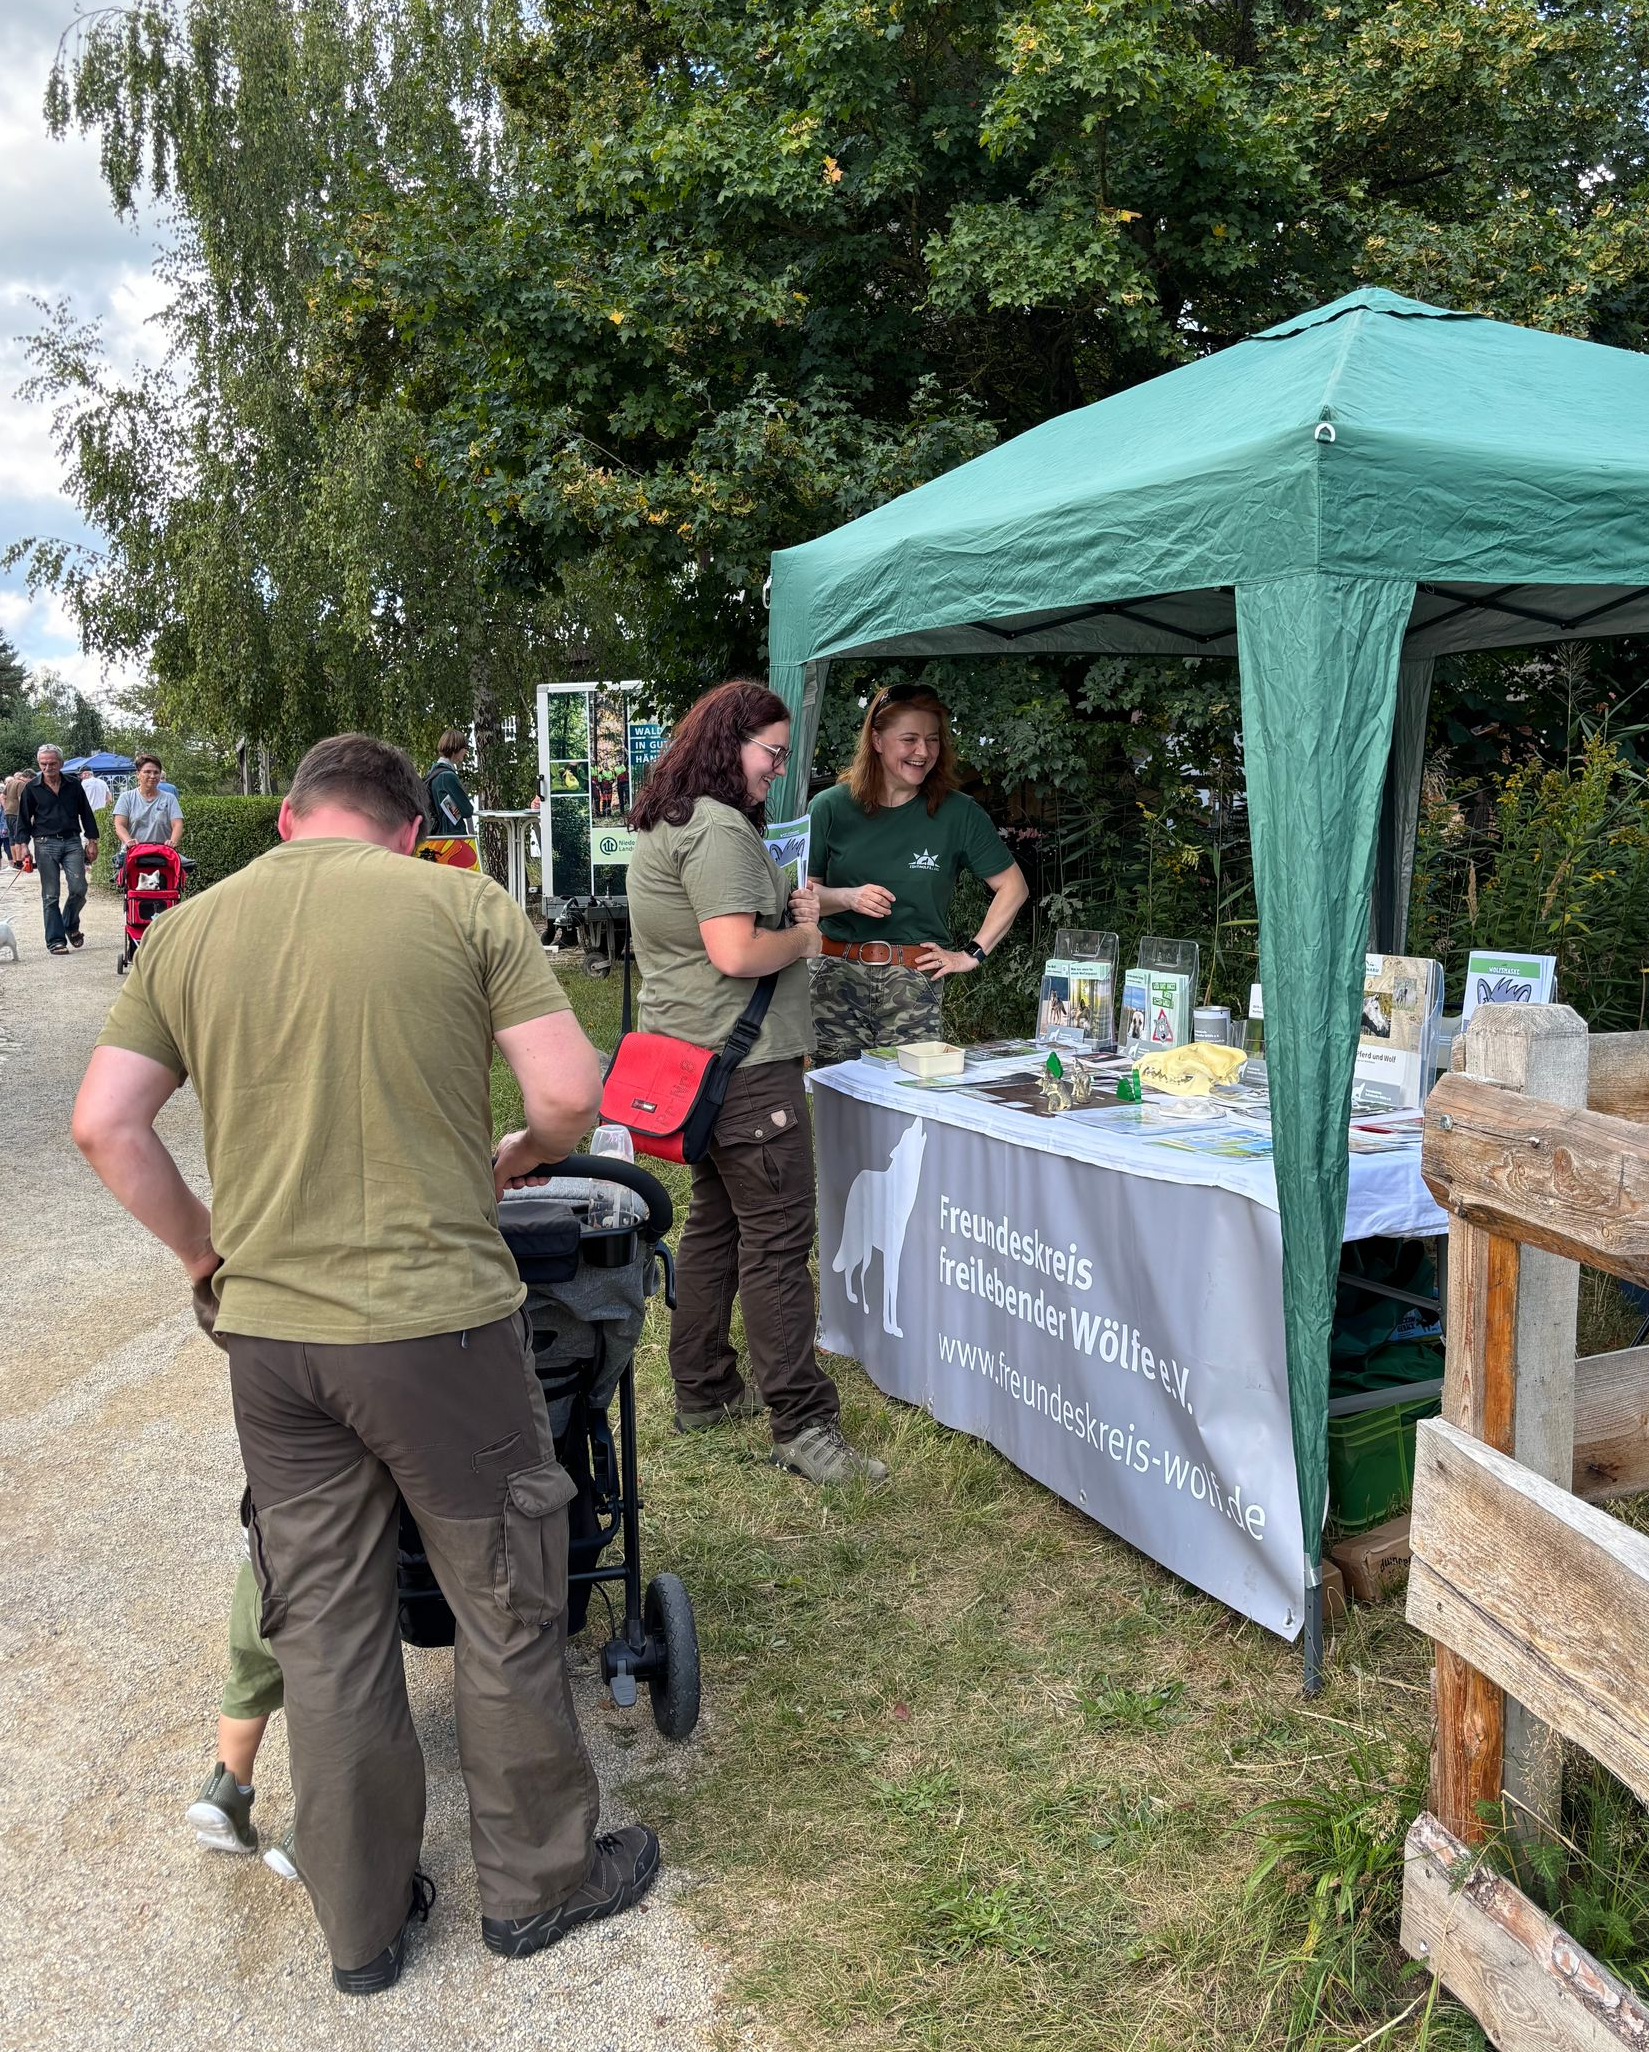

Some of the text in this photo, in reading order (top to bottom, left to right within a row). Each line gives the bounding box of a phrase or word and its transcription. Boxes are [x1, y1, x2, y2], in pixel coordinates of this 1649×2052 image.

[635, 741, 646, 750] IN
[635, 753, 660, 763] HÄN
[1384, 1055, 1397, 1063] Wolf
[940, 1195, 1093, 1290] Freundeskreis
[939, 1246, 1194, 1415] freilebender Wölfe e.V.
[939, 1332, 1266, 1541] www.freundeskreis-wolf.de
